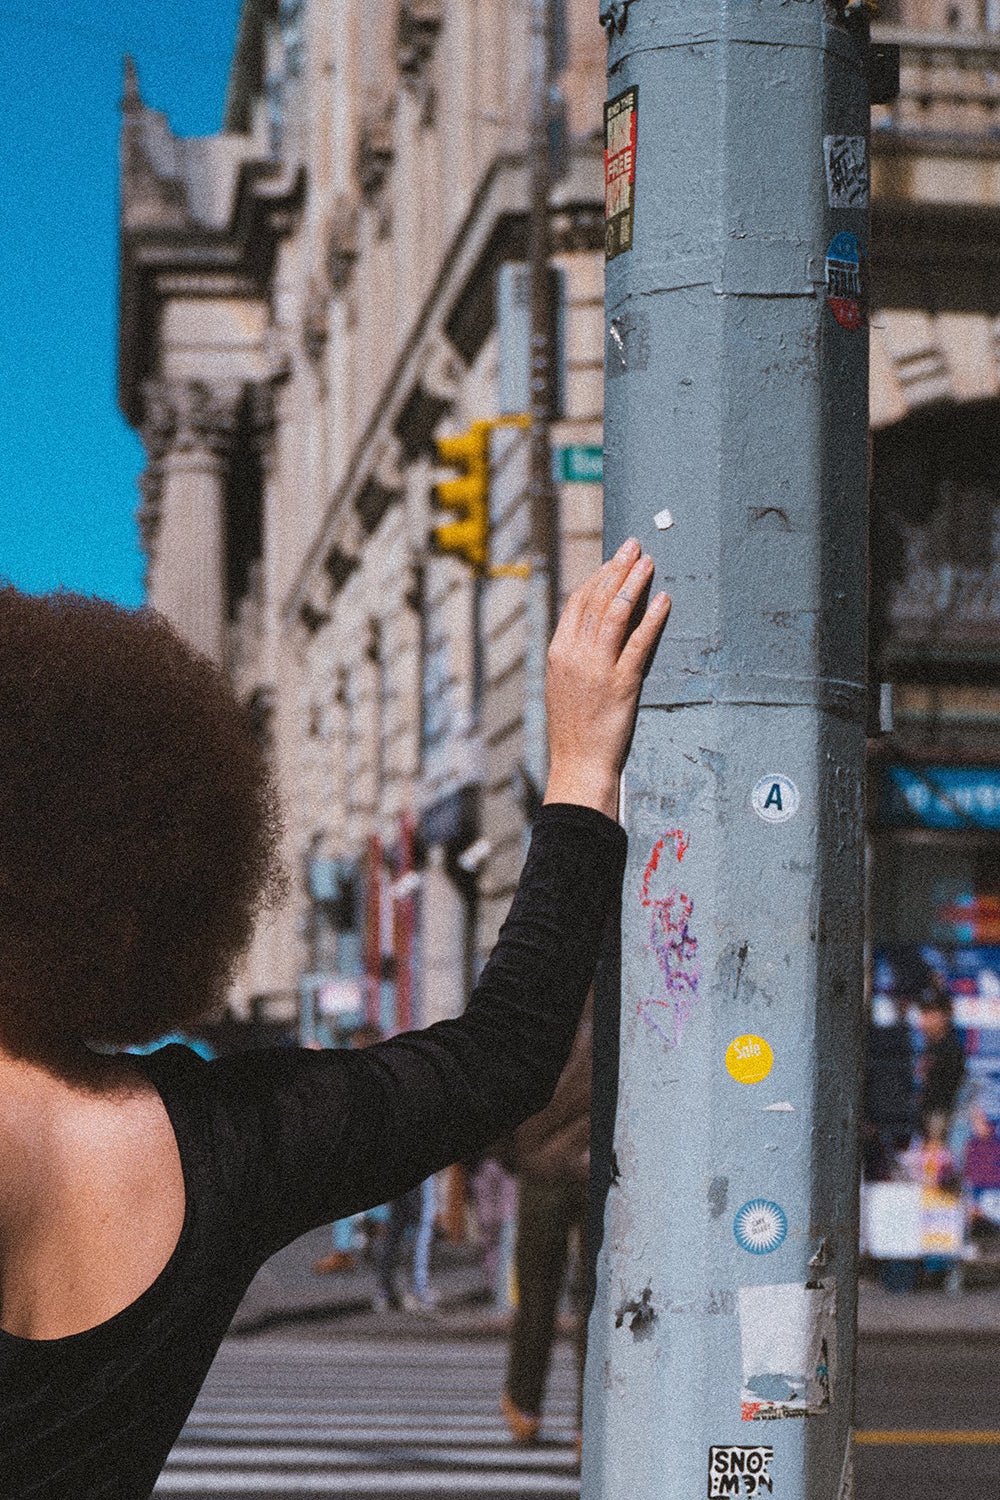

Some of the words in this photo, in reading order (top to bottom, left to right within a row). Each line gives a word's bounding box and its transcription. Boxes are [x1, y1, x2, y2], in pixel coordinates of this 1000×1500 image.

[608, 150, 632, 180] FREE
[764, 783, 783, 811] A
[733, 1037, 761, 1061] Sale
